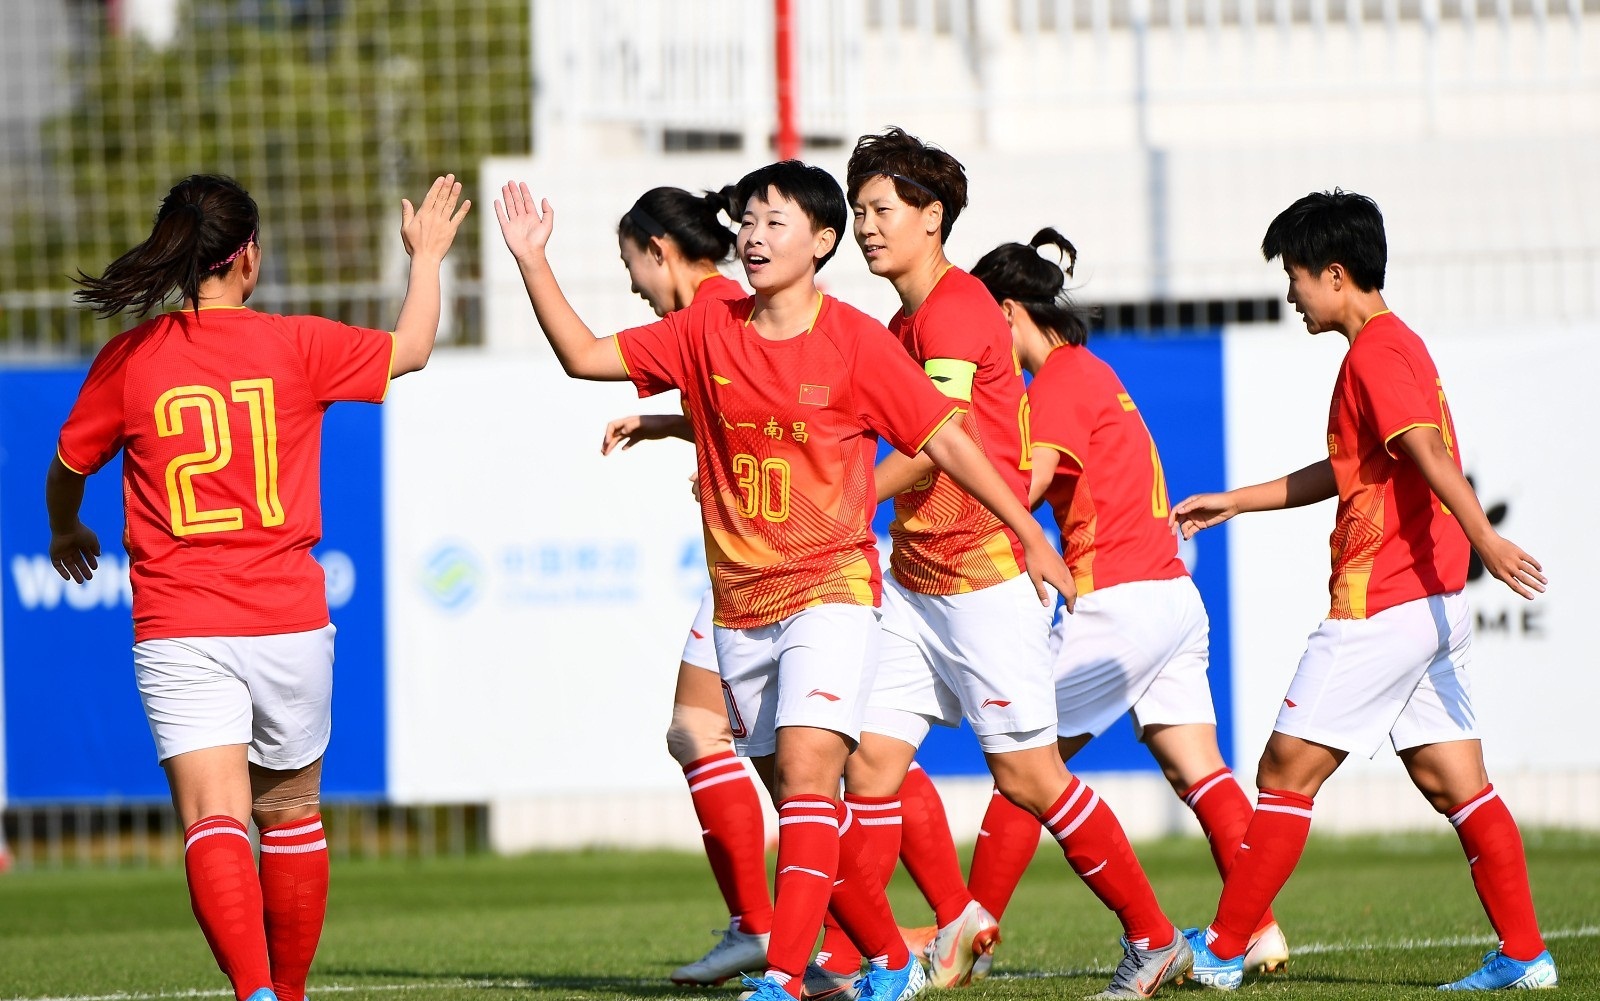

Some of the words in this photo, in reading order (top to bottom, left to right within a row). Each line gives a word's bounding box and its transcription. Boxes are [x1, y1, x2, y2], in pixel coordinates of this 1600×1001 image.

[153, 377, 285, 537] 21
[732, 453, 790, 523] 30
[11, 553, 132, 611] WUH
[1473, 605, 1548, 638] ME
